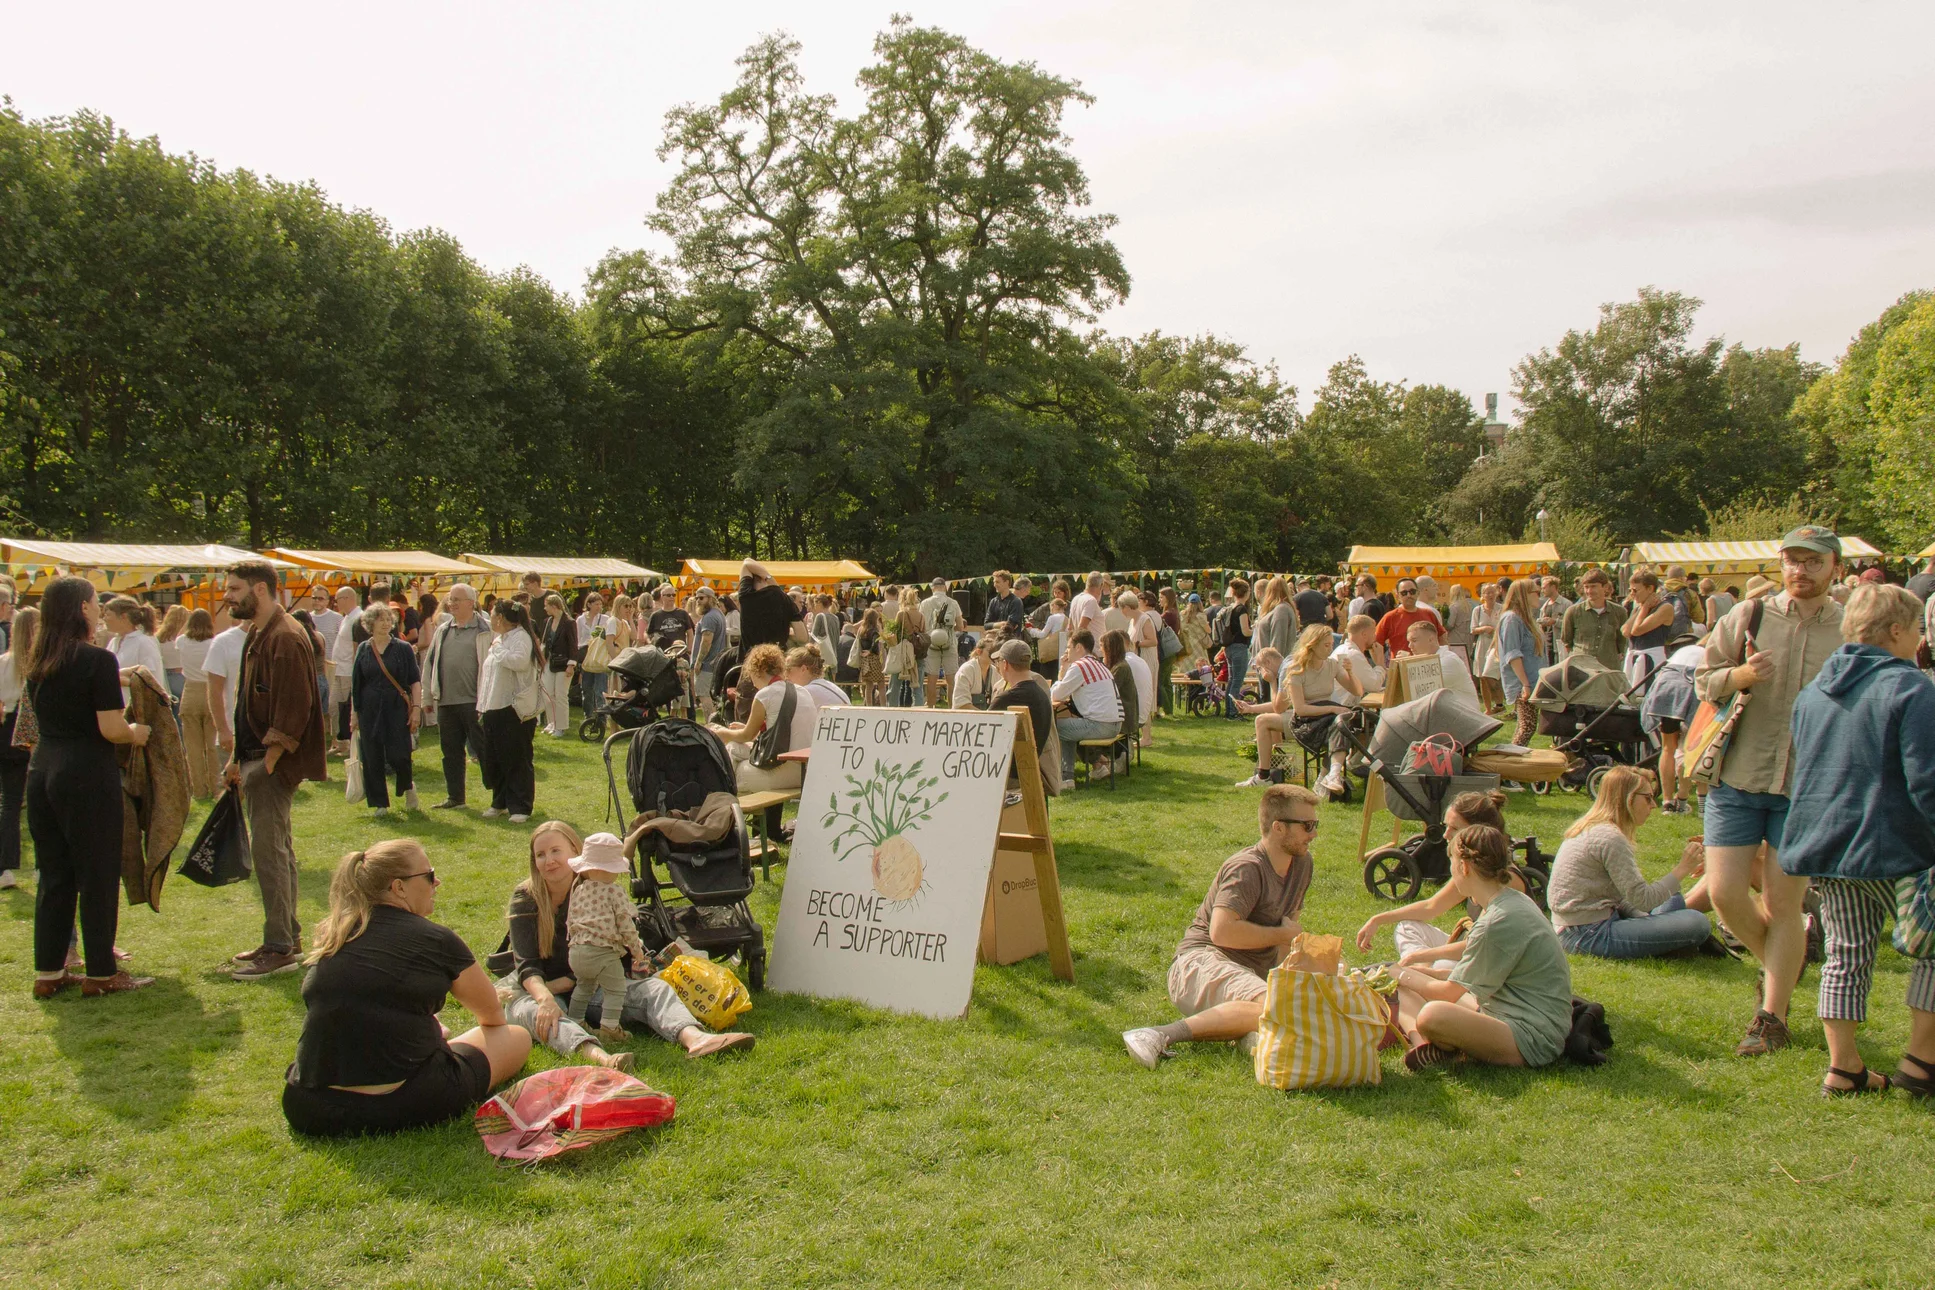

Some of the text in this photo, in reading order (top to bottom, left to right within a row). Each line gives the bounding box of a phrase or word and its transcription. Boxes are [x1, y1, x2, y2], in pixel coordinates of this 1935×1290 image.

[817, 716, 1003, 748] HELP OUR MARKET
[840, 745, 1007, 779] TO GROW
[1010, 878, 1037, 891] DropBuc
[807, 889, 887, 923] BECOME
[813, 920, 948, 963] A SUPPORTER
[677, 966, 717, 1002] Her er e
